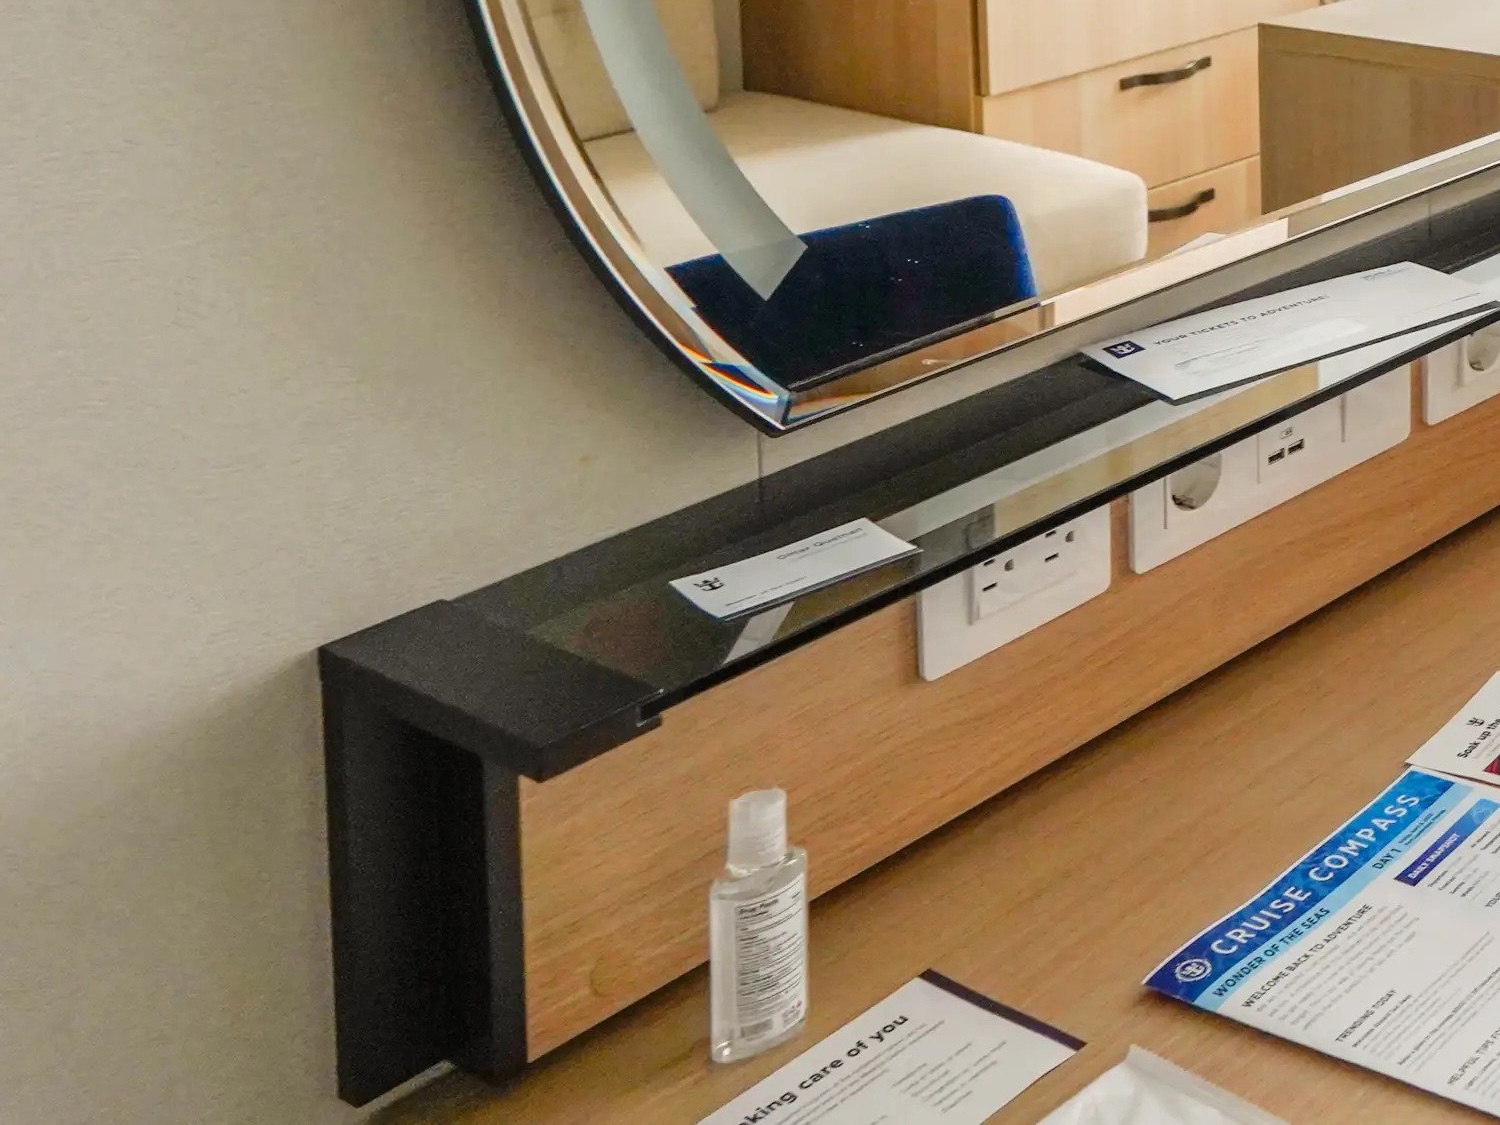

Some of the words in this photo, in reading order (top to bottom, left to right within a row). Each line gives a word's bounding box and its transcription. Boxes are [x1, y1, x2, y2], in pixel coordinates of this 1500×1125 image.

[1152, 333, 1188, 346] YOUR
[1188, 319, 1238, 336] TICKETS
[1239, 314, 1257, 322] TO
[1456, 740, 1481, 758] Soak
[1475, 730, 1493, 740] up
[1209, 885, 1312, 956] CRUISE
[1307, 793, 1421, 882] COMPASS
[1370, 852, 1397, 870] DAY
[1406, 861, 1430, 878] DAILY
[1424, 832, 1461, 862] SNAPSHOT
[1211, 956, 1267, 997] WONDER
[1261, 943, 1283, 957] OF
[1278, 927, 1305, 944] THE
[1299, 906, 1332, 929] SEAS
[1240, 970, 1290, 1008] WELCOME
[1284, 952, 1313, 972] BACK
[1308, 942, 1326, 953] TO
[1320, 903, 1374, 943] ADVENTURE
[1333, 1008, 1376, 1043] TRENDING
[1370, 987, 1399, 1009] TODAY
[798, 1059, 843, 1089] care
[846, 1041, 869, 1058] of
[869, 1014, 909, 1043] you
[1445, 1054, 1481, 1086] HELPFUL
[1475, 1039, 1495, 1055] TIPS
